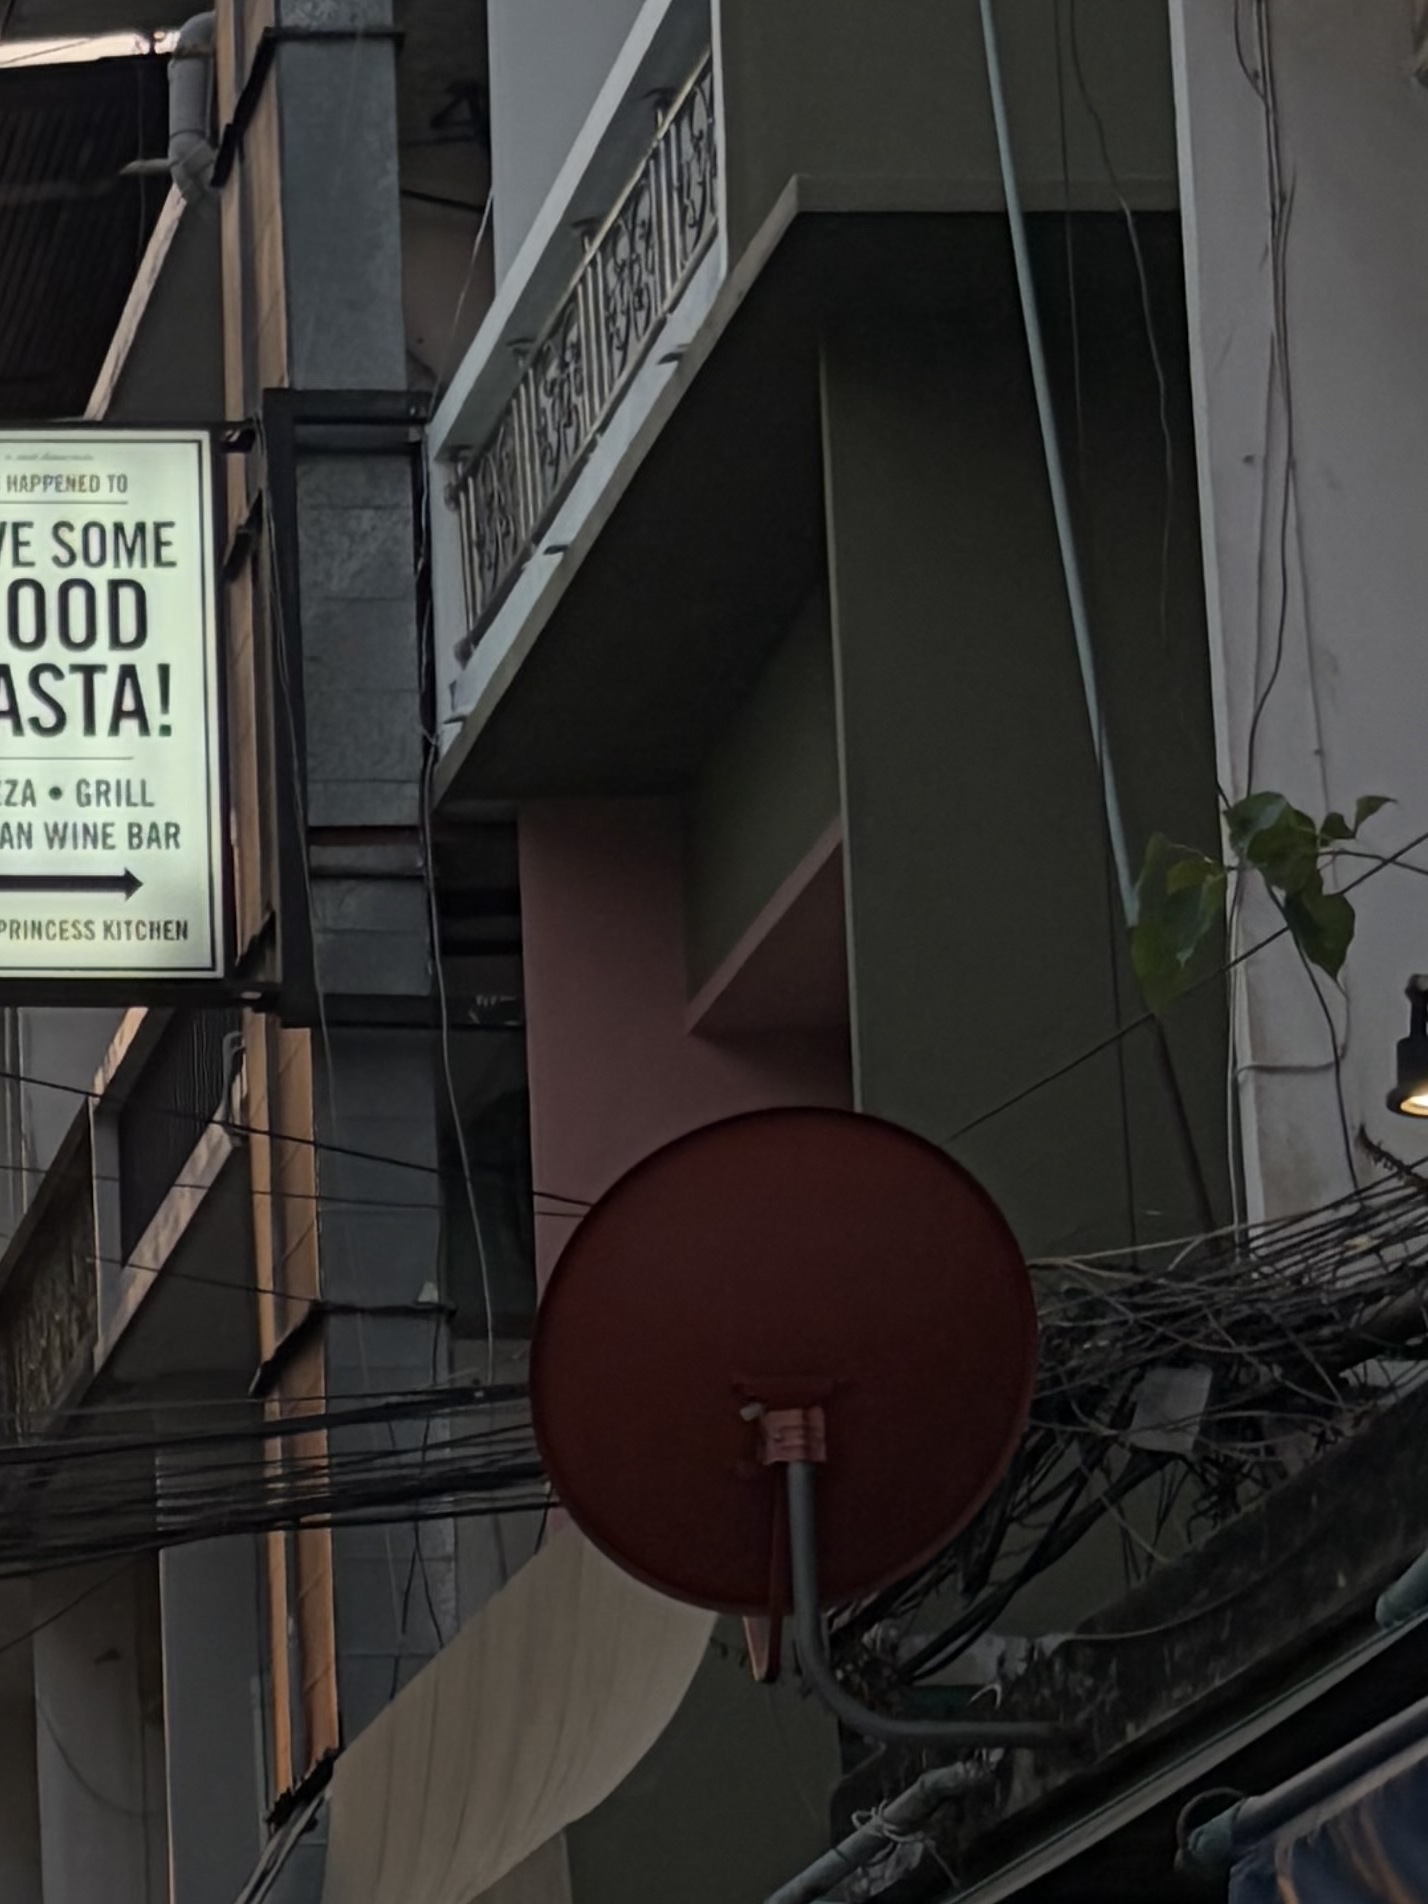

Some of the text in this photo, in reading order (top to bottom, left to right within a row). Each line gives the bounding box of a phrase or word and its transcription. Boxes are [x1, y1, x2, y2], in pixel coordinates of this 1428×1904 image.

[6, 473, 101, 494] HAPPENED
[108, 474, 129, 494] TO
[51, 520, 178, 569] SOME
[76, 778, 155, 808] GRILL
[44, 821, 116, 850] WINE
[127, 821, 181, 850] BAR
[103, 917, 189, 942] KITCHEN
